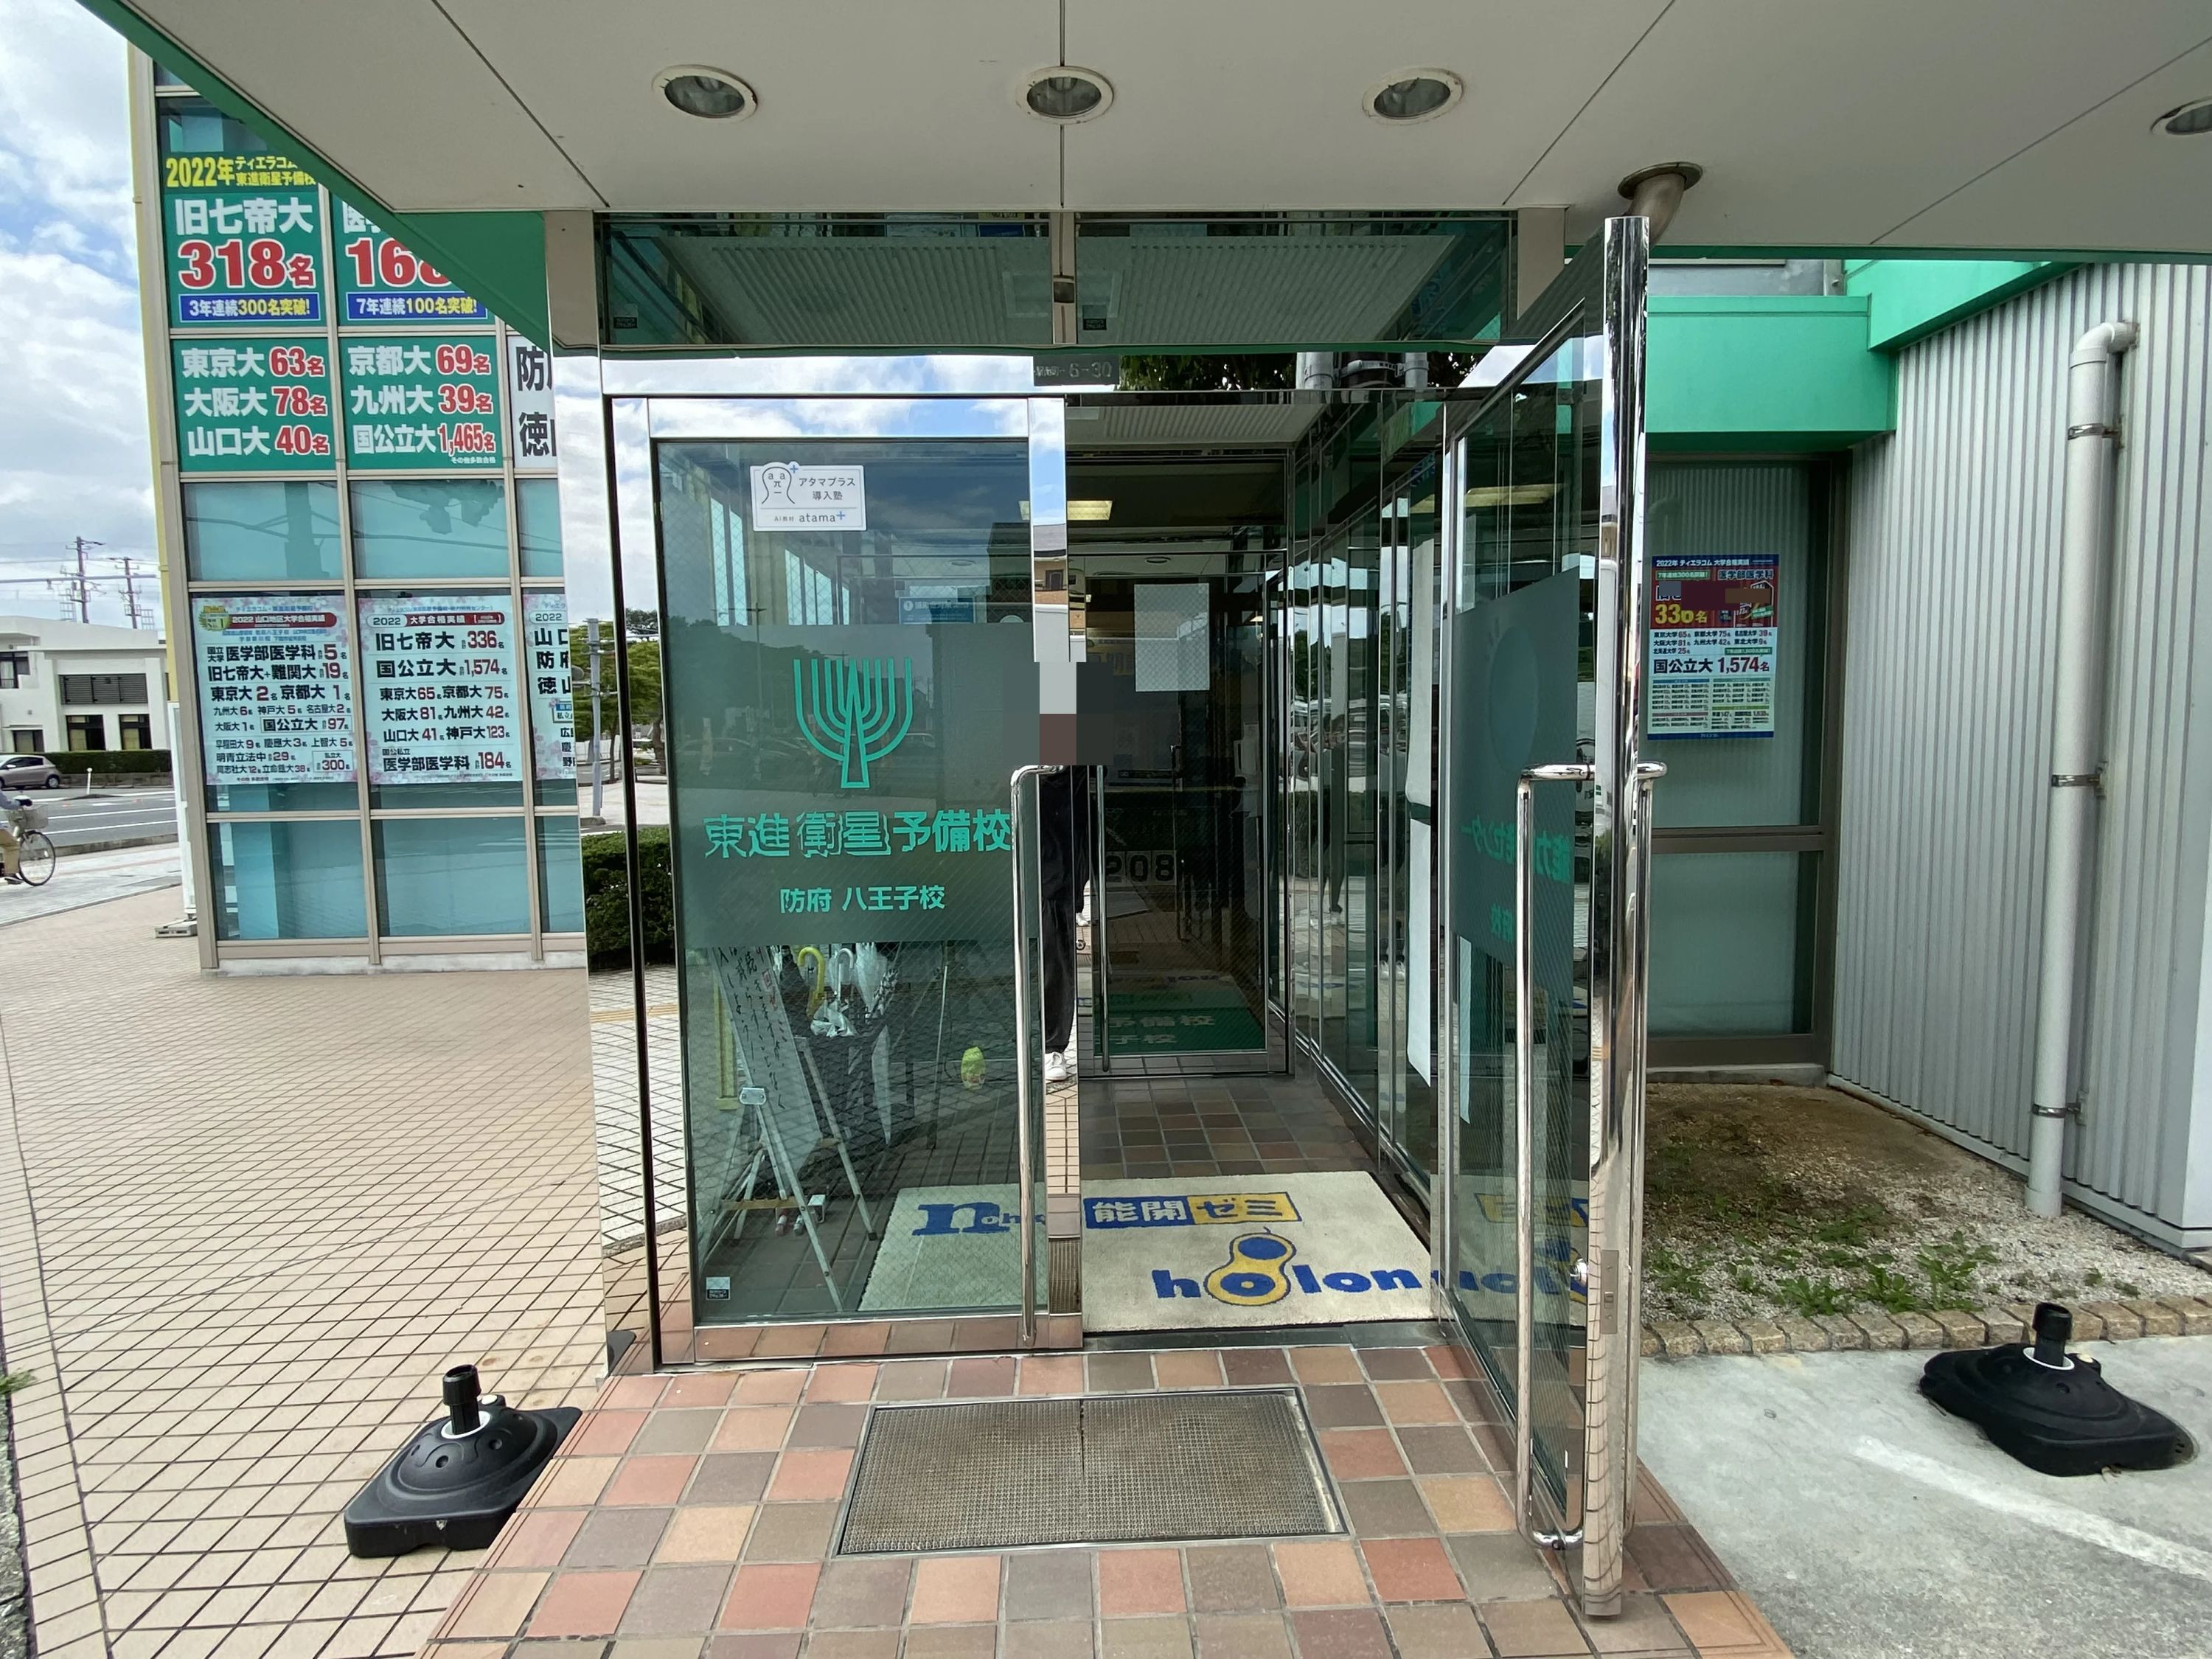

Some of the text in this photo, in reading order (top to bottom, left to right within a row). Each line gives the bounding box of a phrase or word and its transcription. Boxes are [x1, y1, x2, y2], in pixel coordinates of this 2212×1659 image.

[166, 157, 234, 187] 2022年
[175, 198, 313, 234] 旧七帝大
[342, 201, 380, 233] 医
[178, 239, 316, 288] 318名
[181, 347, 324, 378] 東京大 63名
[347, 345, 490, 376] 京都大 69名
[517, 346, 552, 391] 防
[184, 386, 327, 417] 大阪大 78名
[351, 385, 493, 415] 九州大 39名
[188, 425, 330, 456] 山口大 40名
[354, 424, 495, 456] 国公立大 1,465名
[519, 411, 557, 456] 徳
[799, 478, 855, 487] アタマプラス
[373, 617, 400, 625] 2022
[535, 613, 563, 622] 2022
[226, 646, 316, 661] 医学部医学科
[375, 632, 455, 651] 旧七帝大
[376, 658, 456, 678] 国公立大
[1654, 659, 1713, 673] 国公立大
[210, 686, 252, 701] 東京大
[280, 684, 325, 700] 京都大
[380, 687, 417, 701] 東京大
[442, 686, 481, 699] 京都大
[263, 718, 318, 731] 国公立大
[381, 708, 418, 721] 大阪大
[444, 706, 483, 719] 九州大
[383, 728, 419, 742] 山口大
[446, 726, 485, 740] 神戸大
[383, 756, 470, 771] 医学部医学科
[703, 808, 1012, 858] 東進衛星予備校
[780, 885, 945, 914] 防府 八王子校
[1093, 1197, 1285, 1223] 能開ゼミ
